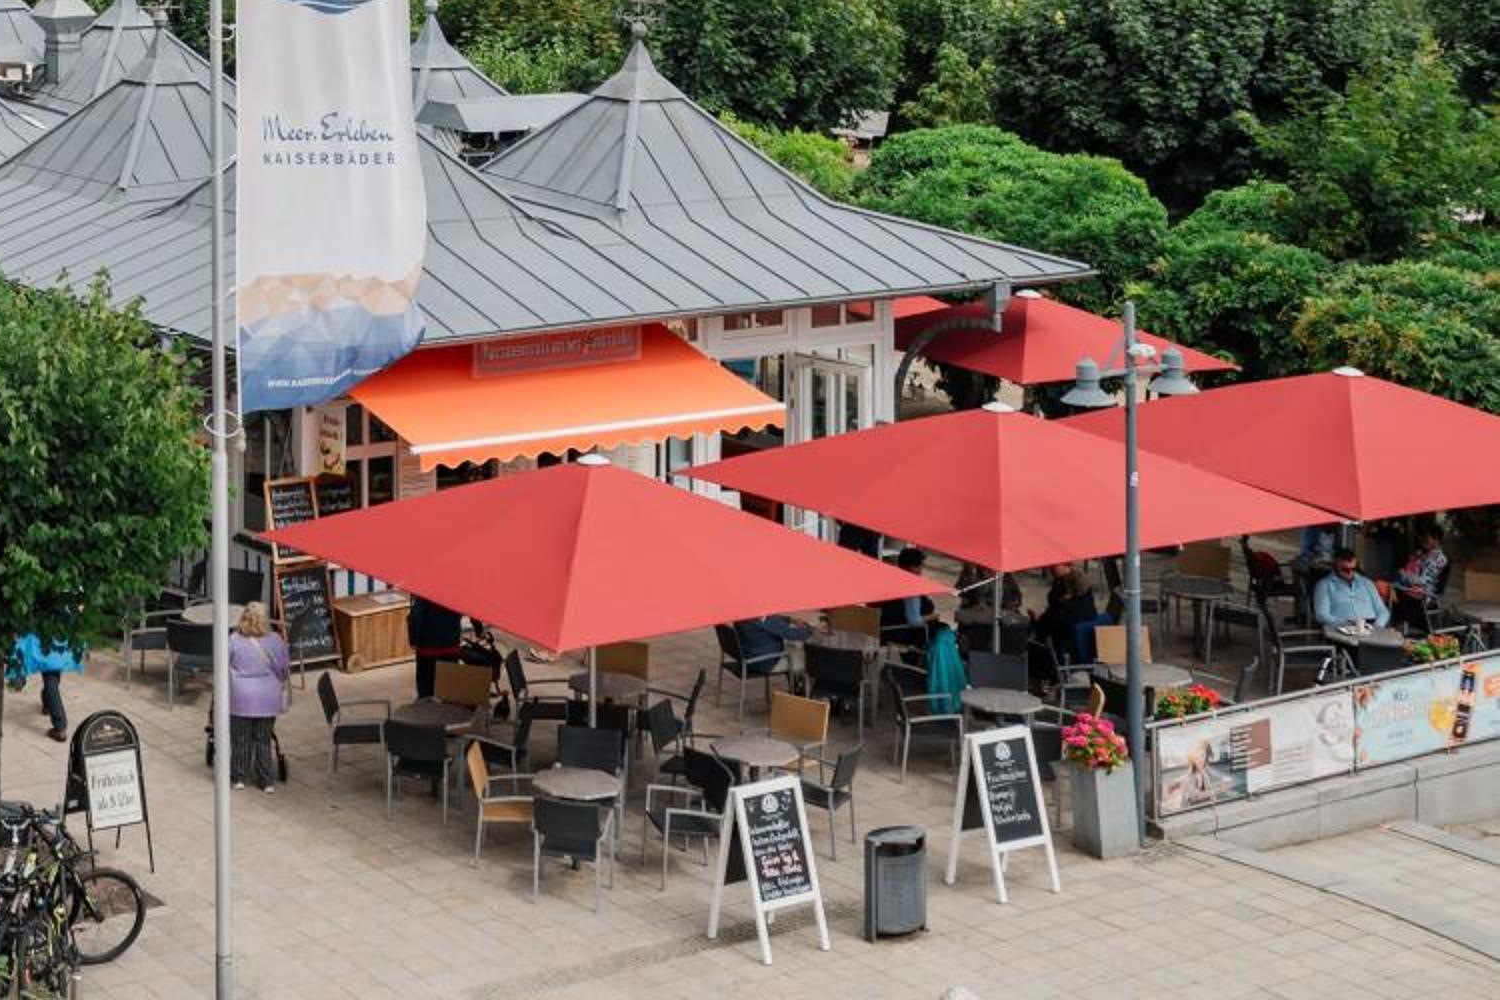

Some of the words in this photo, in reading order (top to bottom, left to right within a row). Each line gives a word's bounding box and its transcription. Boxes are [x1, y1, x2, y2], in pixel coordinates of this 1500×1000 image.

[262, 114, 318, 141] Meer.
[320, 111, 394, 141] Erleben
[263, 150, 396, 165] KAISERBÄDER
